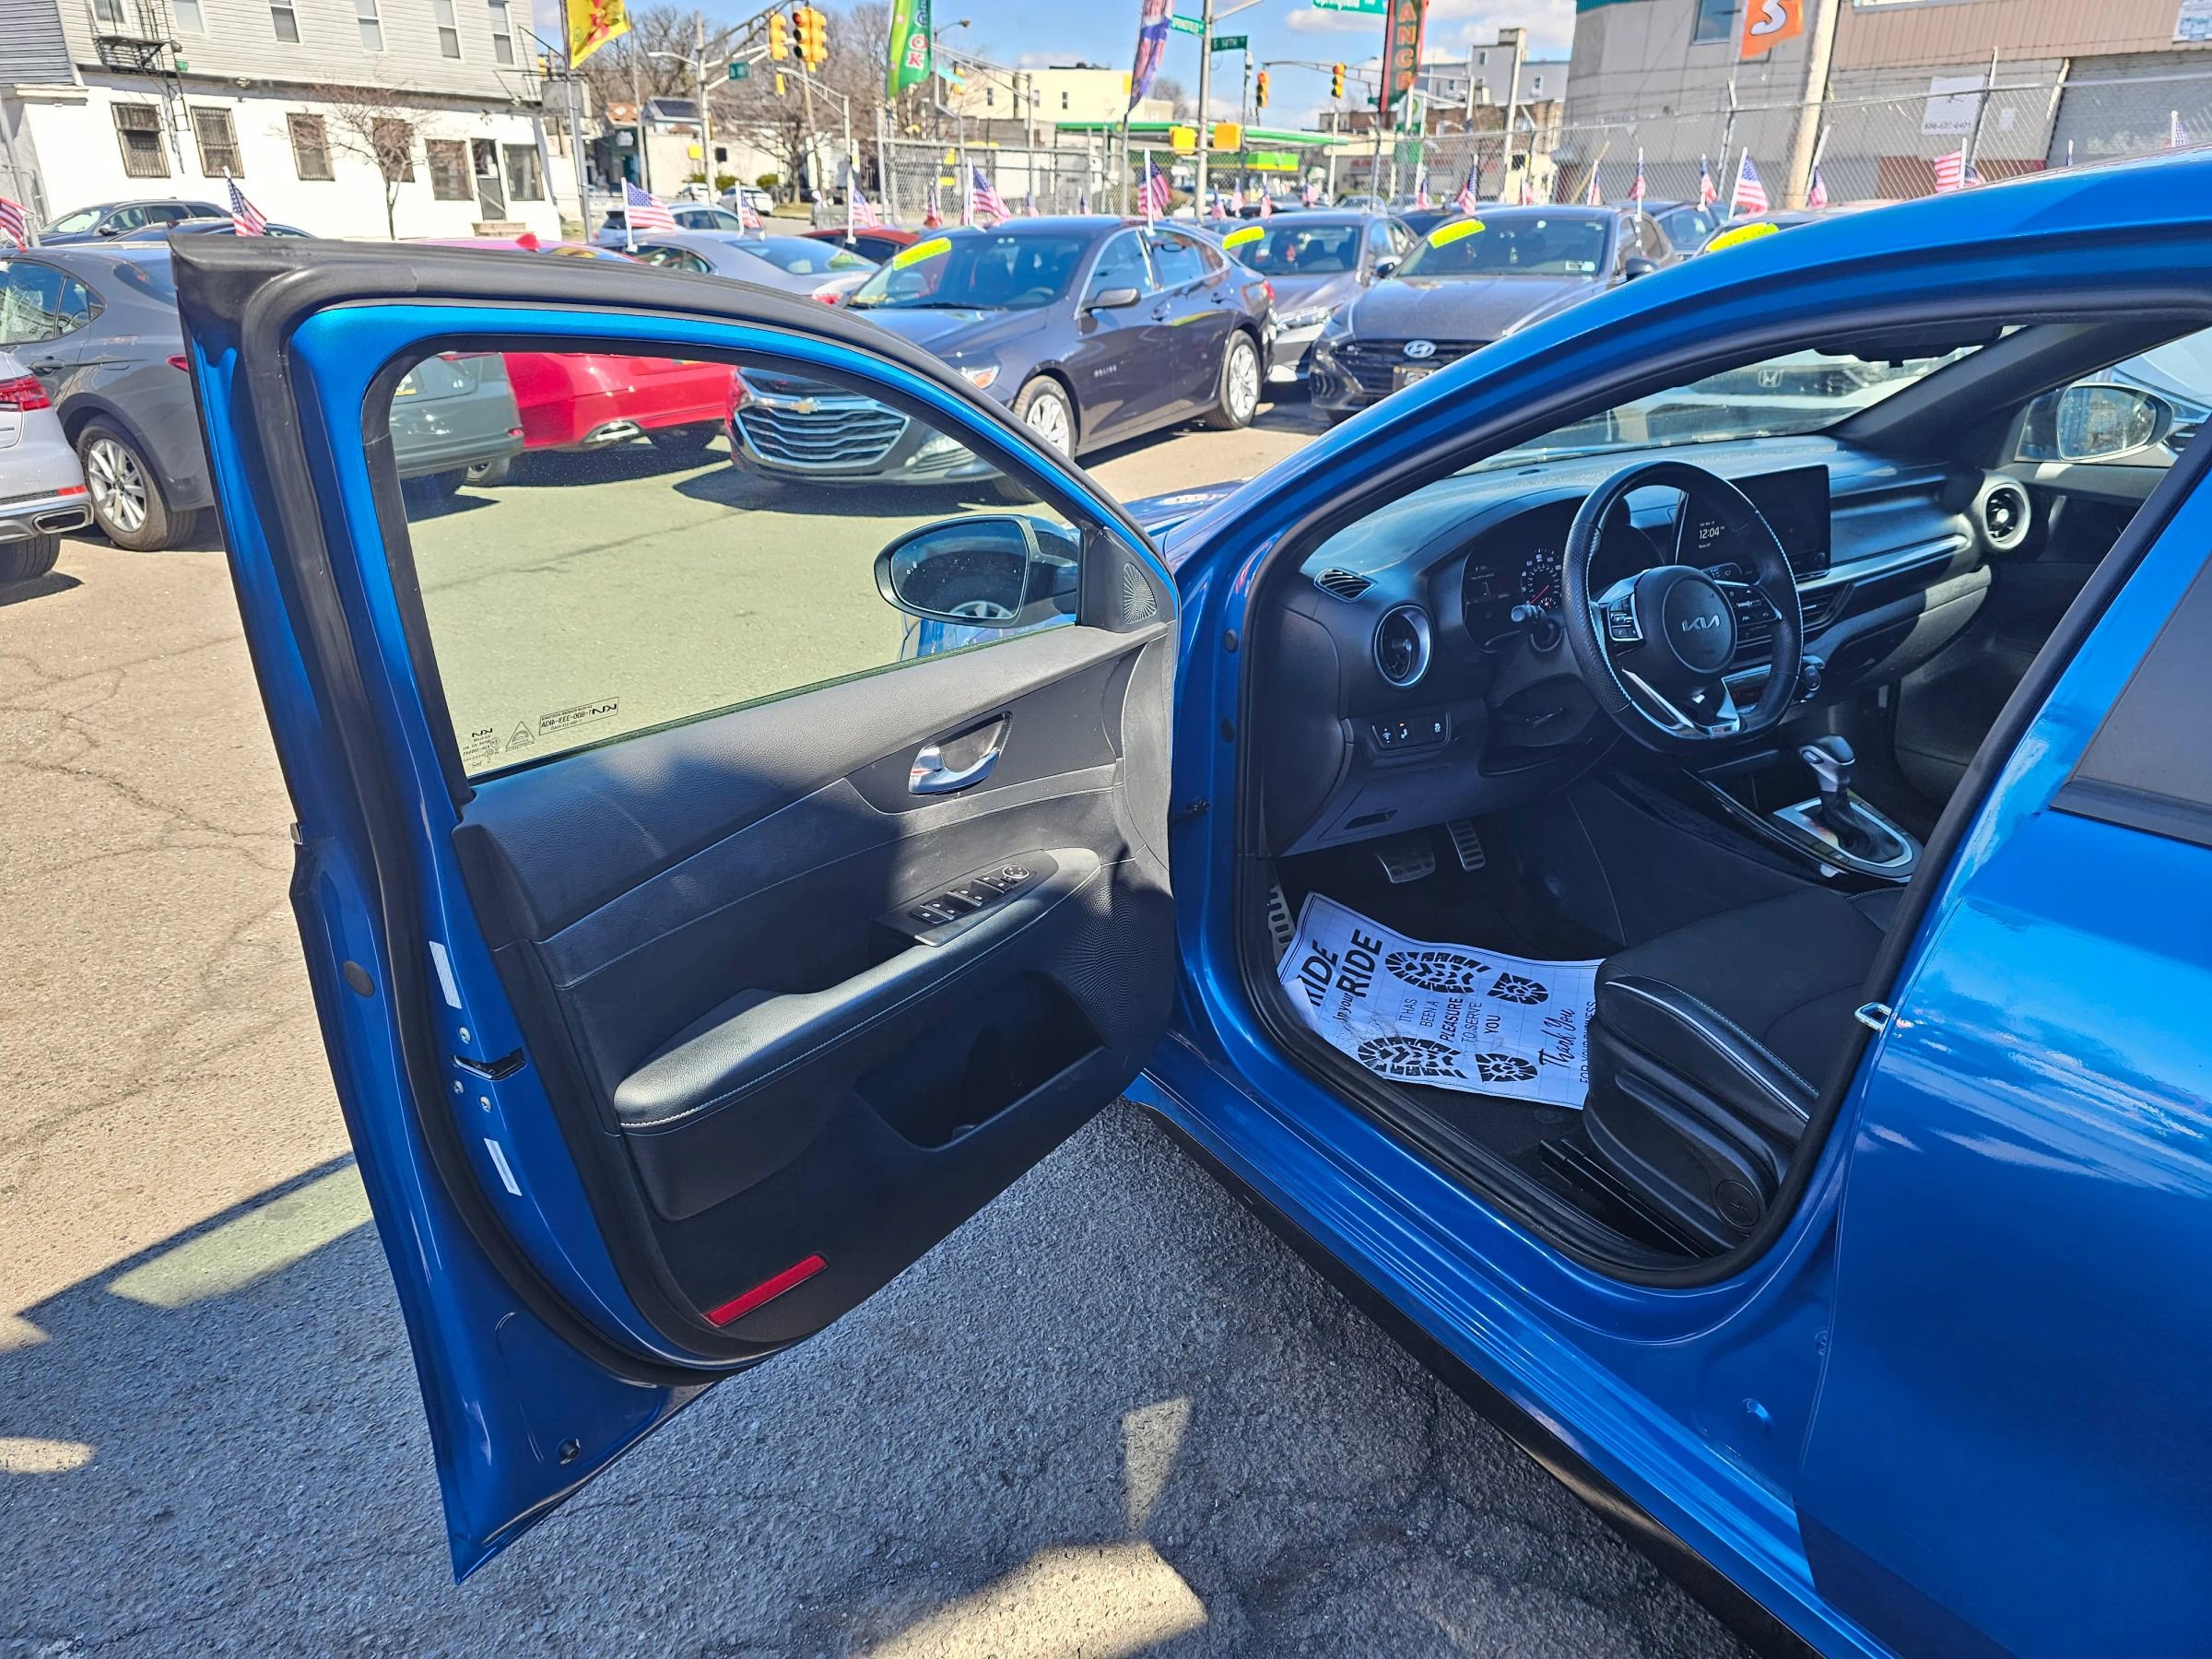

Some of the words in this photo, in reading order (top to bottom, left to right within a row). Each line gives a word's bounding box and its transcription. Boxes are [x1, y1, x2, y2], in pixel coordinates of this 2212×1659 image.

[1700, 526, 1720, 539] 12:04
[1335, 929, 1382, 997] RIDE
[1339, 993, 1354, 1014] your
[1402, 998, 1418, 1015] HAS
[1420, 1007, 1438, 1028] BEEN
[1440, 997, 1464, 1042] PLEASURE
[1465, 1002, 1482, 1031] SERVE
[1484, 1015, 1501, 1034] YOU
[1543, 1008, 1576, 1031] You
[1462, 1030, 1477, 1043] TO
[1538, 1030, 1577, 1068] Thank
